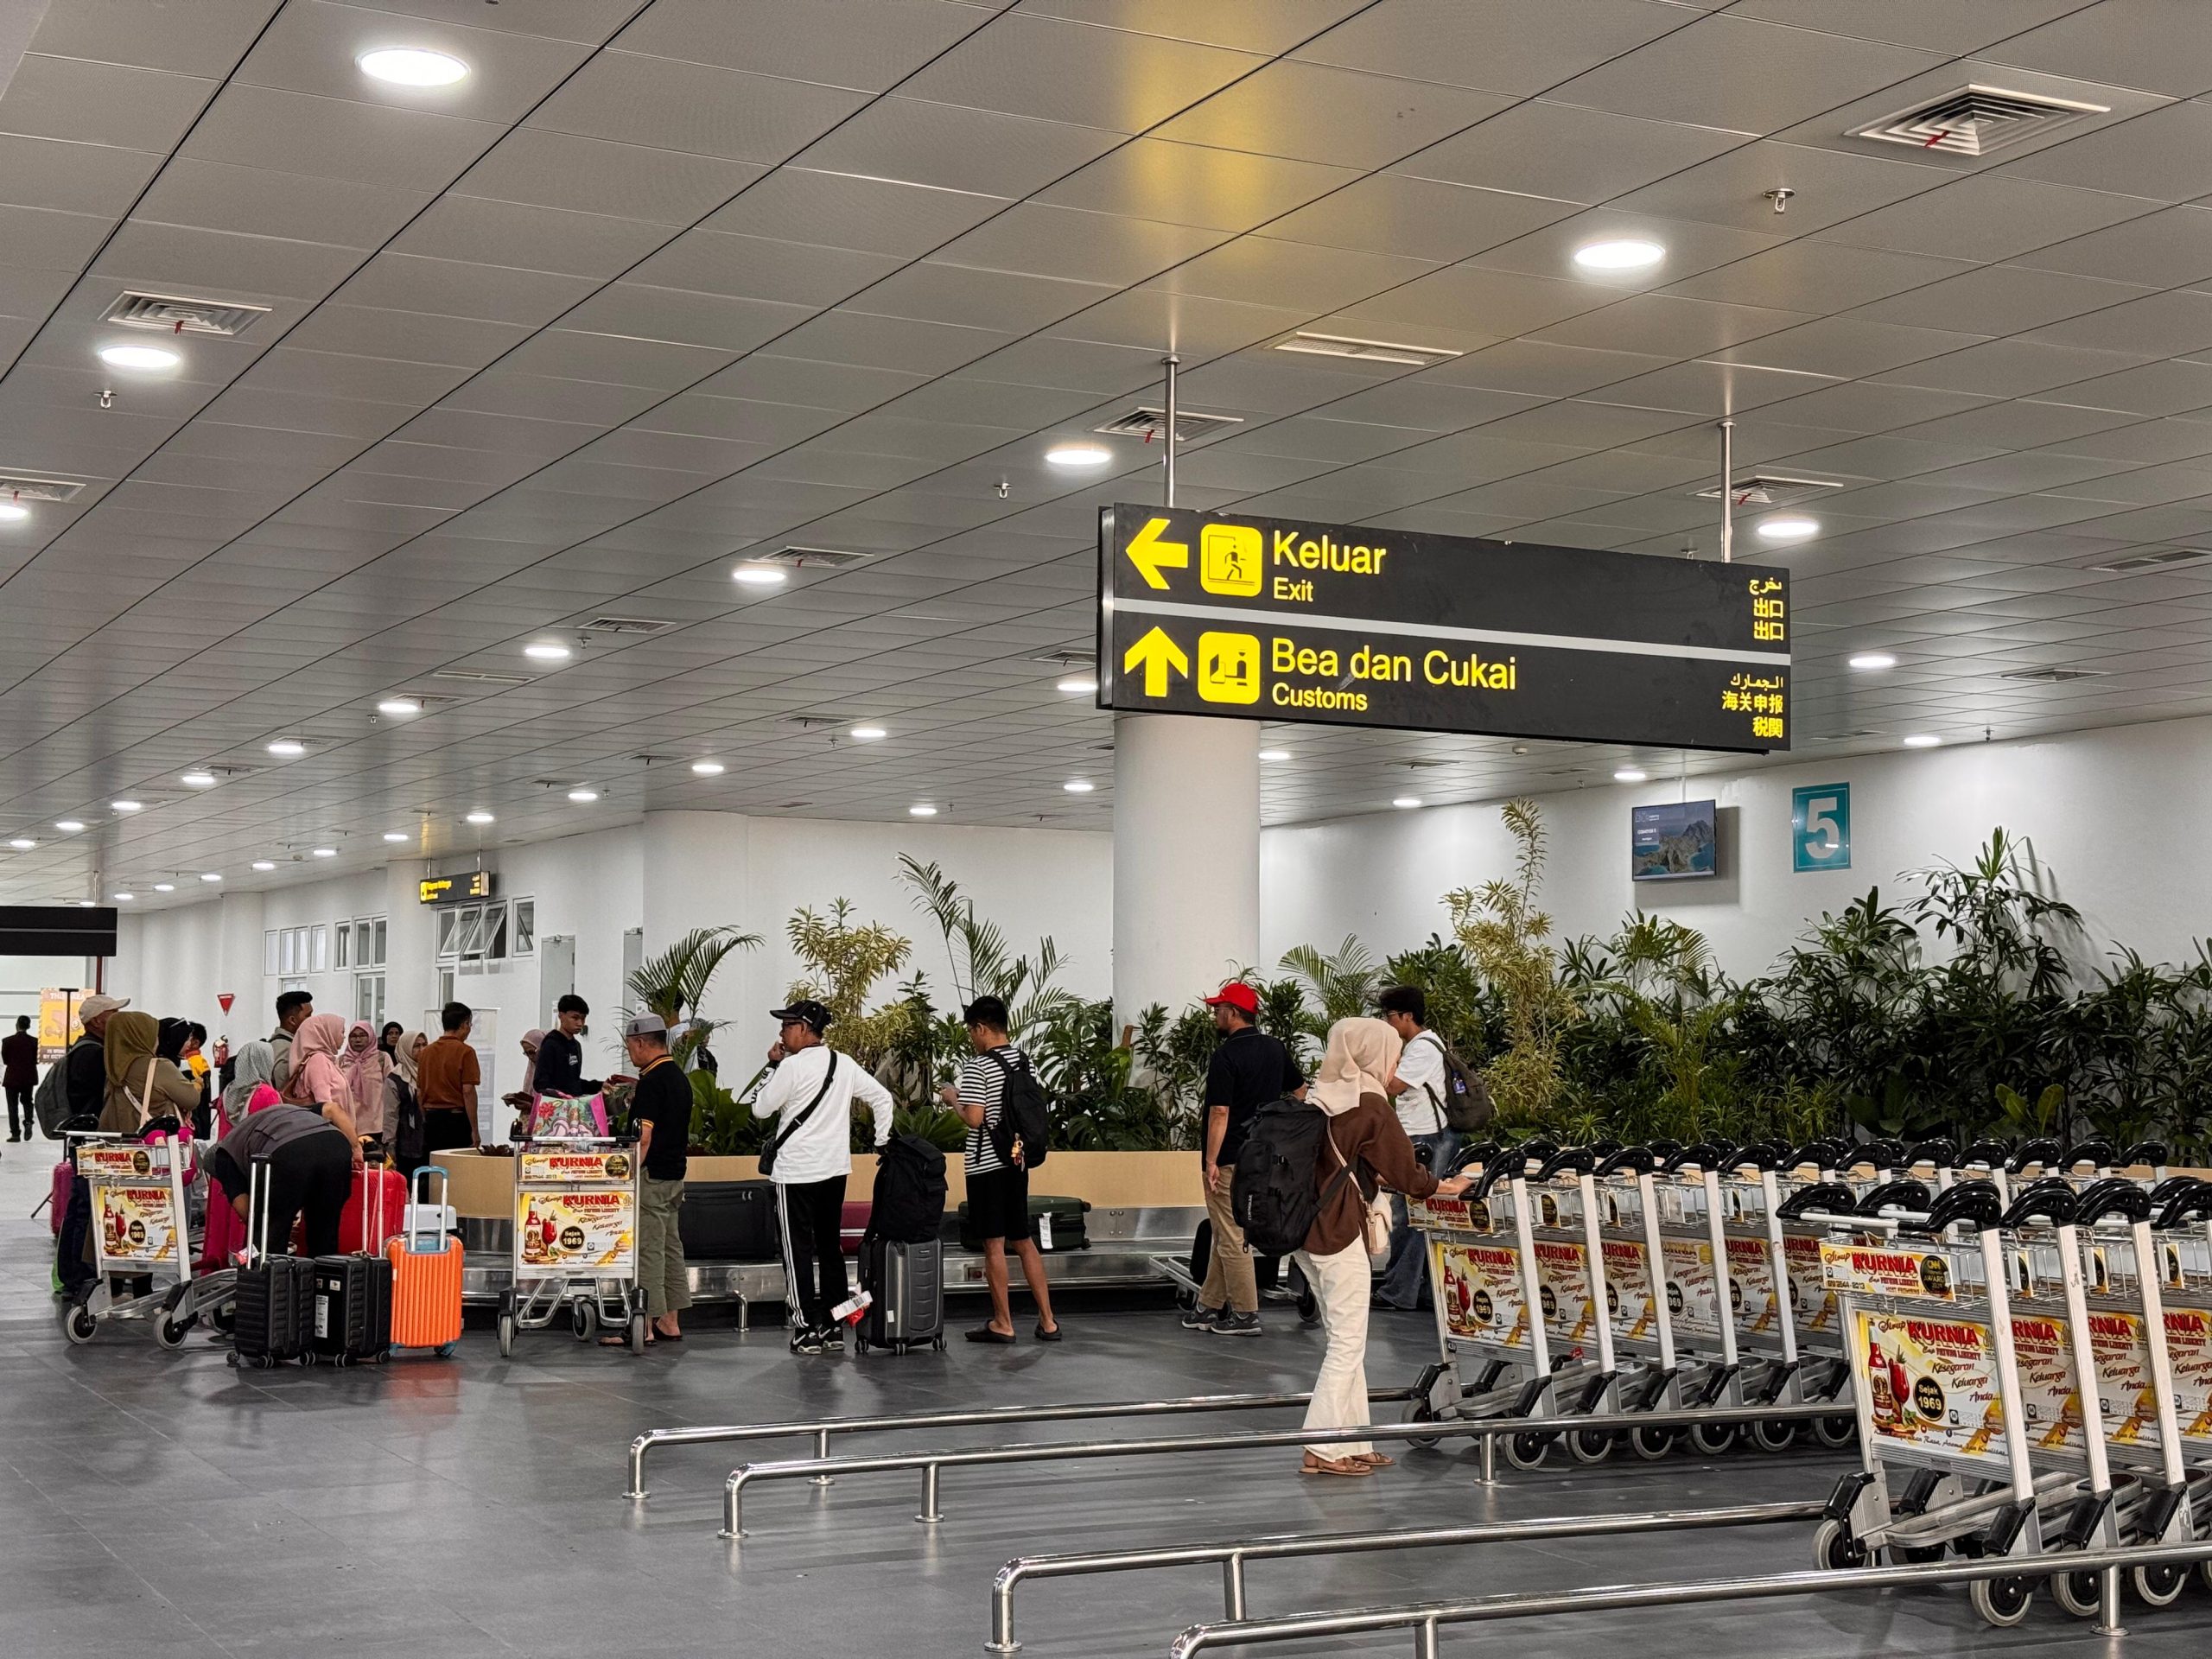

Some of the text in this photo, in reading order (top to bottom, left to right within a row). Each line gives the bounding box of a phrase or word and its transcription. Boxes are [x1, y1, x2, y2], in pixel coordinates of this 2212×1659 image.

[1274, 530, 1387, 575] Keluar
[1273, 576, 1314, 602] Exit
[1753, 597, 1784, 619] 出口
[1753, 620, 1784, 641] 出口
[1272, 638, 1516, 690] Bea dan Cukai
[1272, 682, 1368, 711] Customs
[1721, 690, 1783, 715] 海关申报
[1805, 797, 1840, 859] 5
[550, 1157, 603, 1168] KURNIA
[127, 1189, 166, 1201] KURNIA
[563, 1194, 620, 1208] KURNIA
[1426, 1198, 1469, 1213] KURNIA
[1467, 1249, 1514, 1266] KURNIA
[1852, 1251, 1918, 1275] KURNIA
[1477, 1304, 1491, 1314] 1969
[1542, 1300, 1554, 1310] 969
[1669, 1297, 1681, 1307] 969
[1906, 1319, 1980, 1347] KURNIA
[2012, 1320, 2058, 1342] RNIA
[2088, 1316, 2132, 1338] RNIA
[2094, 1352, 2126, 1364] segaran
[2169, 1348, 2199, 1361] egaran
[1931, 1362, 1975, 1375] Kesegaran
[2017, 1357, 2052, 1370] esegaran
[2030, 1370, 2066, 1382] Keluarga
[2102, 1365, 2140, 1378] Keluarga
[1918, 1384, 1938, 1395] Sejak
[1951, 1376, 1989, 1389] Keluarga
[1917, 1395, 1942, 1411] 1969
